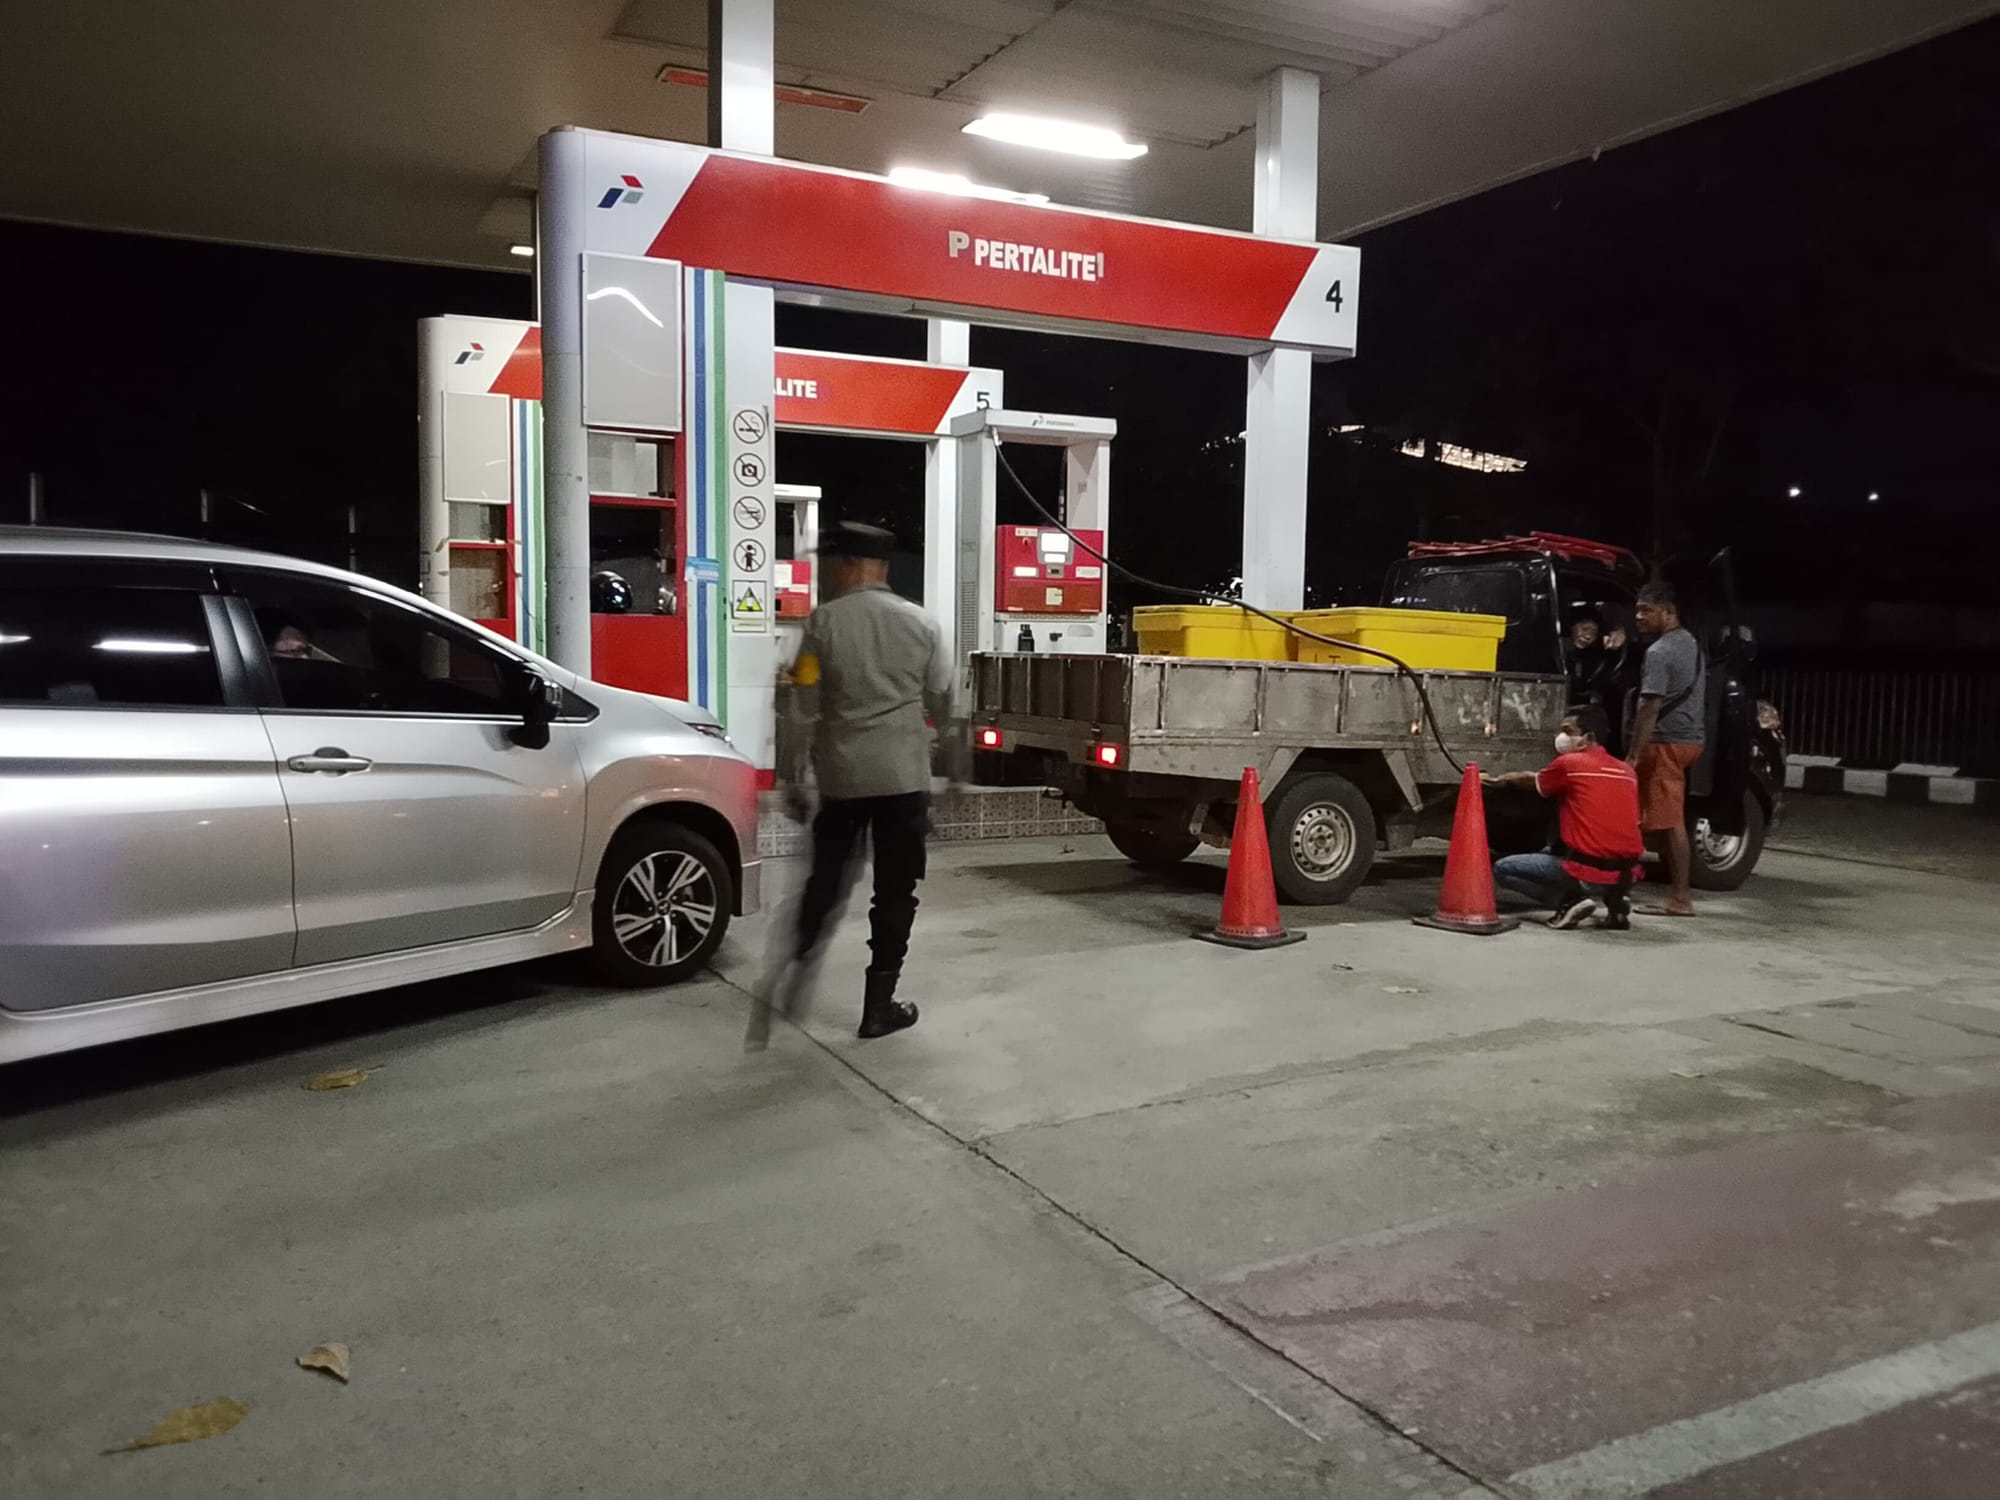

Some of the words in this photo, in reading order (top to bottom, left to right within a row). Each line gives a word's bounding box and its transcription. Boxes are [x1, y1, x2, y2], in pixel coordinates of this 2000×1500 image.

[1325, 279, 1343, 313] 4
[773, 377, 818, 399] LITE
[976, 391, 990, 411] 5
